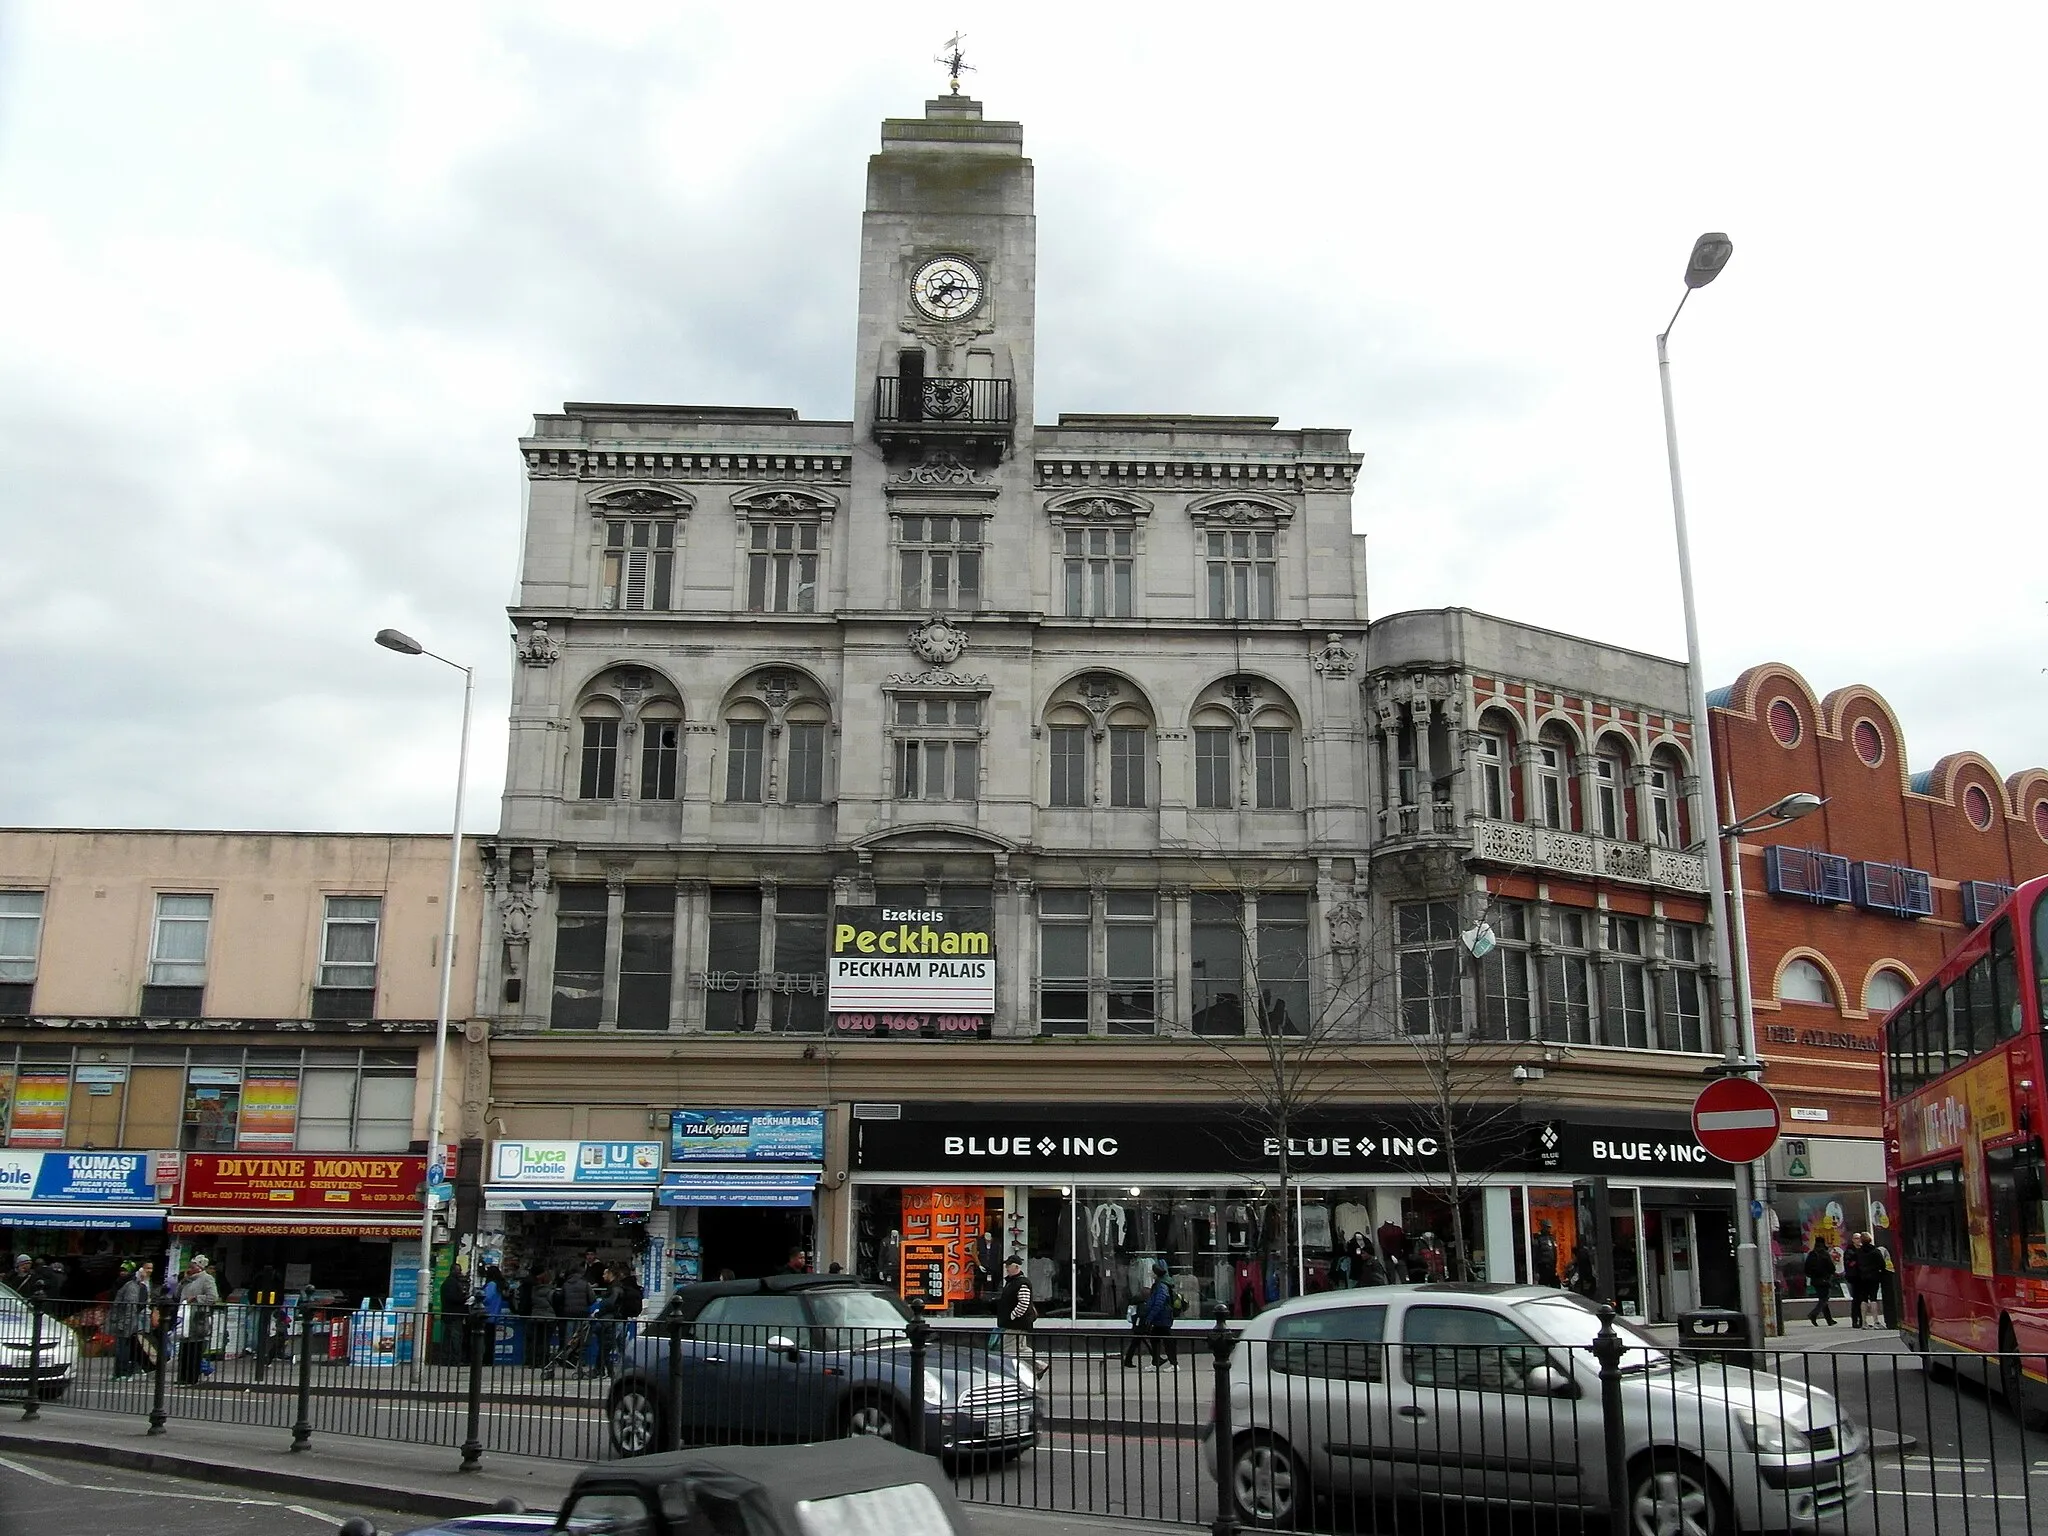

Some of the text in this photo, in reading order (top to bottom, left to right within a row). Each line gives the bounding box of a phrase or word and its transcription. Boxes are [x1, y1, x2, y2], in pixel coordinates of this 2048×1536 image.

[882, 909, 944, 922] Ezekiels
[835, 924, 989, 954] Peckham
[839, 961, 986, 978] PECKHAM PALAIS
[837, 1013, 876, 1030] 020
[1766, 1025, 1798, 1043] THE
[686, 1125, 748, 1134] TALK HOME
[752, 1117, 819, 1126] PECKHAM PALAIS
[612, 1146, 628, 1162] U
[945, 1136, 1118, 1156] BLUE INC
[1263, 1137, 1438, 1156] BLUE INC
[1592, 1140, 1707, 1163] BLUE INC
[68, 1156, 137, 1170] KUMASI
[193, 1159, 203, 1167] 74
[524, 1147, 566, 1164] Lyca
[72, 1170, 130, 1180] MARKET
[217, 1160, 403, 1178] DIVINE MONEY
[523, 1163, 565, 1173] mobile
[248, 1180, 362, 1189] FINANCIAL SERVICES
[934, 1193, 962, 1208] 70%
[194, 1225, 246, 1233] COMMISSION
[248, 1226, 288, 1234] CHARGES
[290, 1226, 308, 1234] AND
[309, 1227, 358, 1235] EXCELLENT
[360, 1227, 381, 1235] RATE
[383, 1227, 388, 1235] &
[391, 1227, 422, 1236] SERVIC
[907, 1215, 930, 1240] LE
